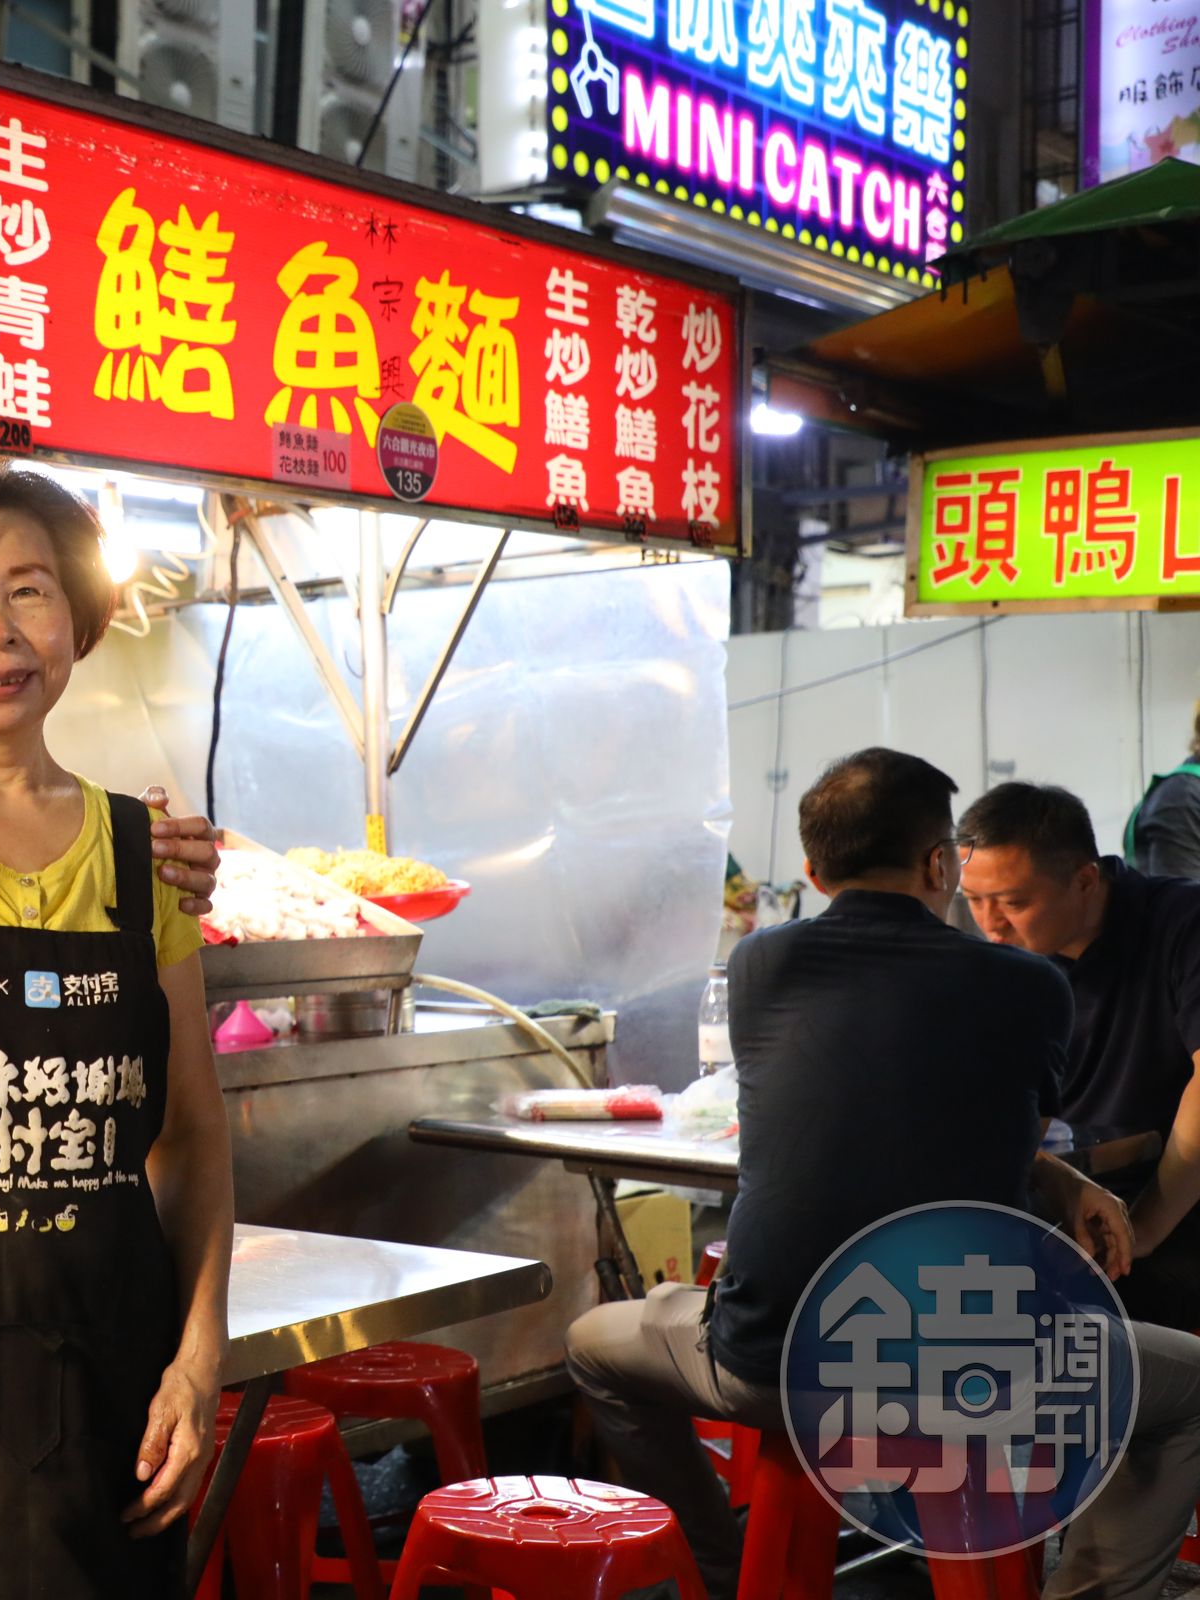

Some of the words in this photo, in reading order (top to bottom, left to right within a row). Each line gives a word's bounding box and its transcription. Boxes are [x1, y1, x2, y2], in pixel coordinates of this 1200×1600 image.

[624, 72, 755, 192] MINI
[763, 130, 921, 253] CATCH
[93, 187, 520, 474] 鱔魚麵
[544, 267, 590, 513] 生炒鱔魚
[615, 284, 658, 522] 乾炒鱔魚
[681, 302, 722, 529] 炒花枝
[323, 449, 346, 475] 100
[396, 470, 422, 494] 135
[67, 993, 118, 1007] ALIPAY
[17, 1175, 49, 1190] Make
[72, 1174, 100, 1192] happy
